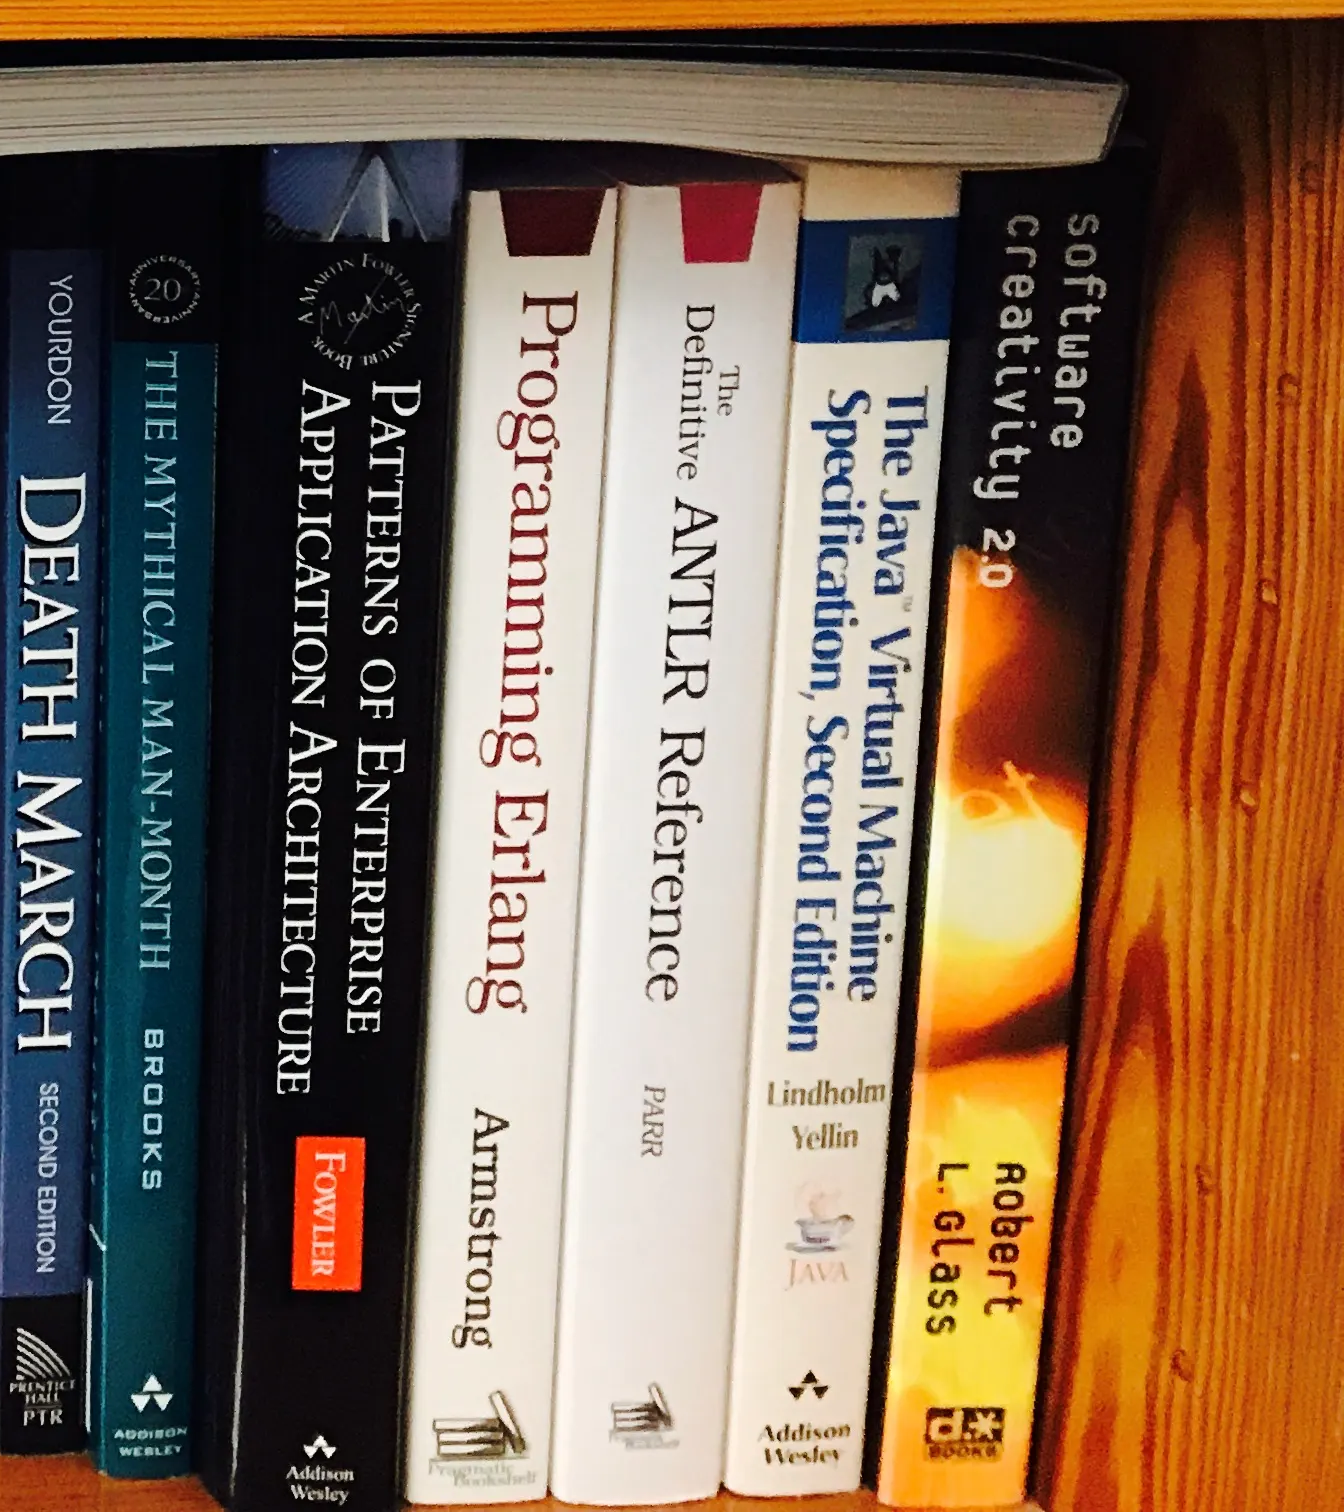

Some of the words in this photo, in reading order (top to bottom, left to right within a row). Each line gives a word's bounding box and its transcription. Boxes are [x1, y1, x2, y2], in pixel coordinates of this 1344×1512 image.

[47, 274, 72, 426] YOURDON
[677, 304, 715, 481] Definitive
[717, 365, 739, 416] The
[971, 214, 1040, 501] creativity
[1049, 211, 1106, 450] software
[144, 350, 178, 441] THE
[141, 452, 177, 684] MYTHICAL
[663, 496, 718, 705] ANTLR
[975, 527, 1016, 589] 2.0
[138, 698, 173, 971] MAN-MONTH
[644, 727, 706, 1002] Reference
[640, 1085, 666, 1158] PARR
[767, 1079, 887, 1107] Lindholm
[792, 1124, 858, 1150] Yellin
[936, 1161, 969, 1194] L.
[984, 1161, 1033, 1315] Robert
[925, 1209, 975, 1336] Glass
[286, 1464, 354, 1482] Addison
[290, 1485, 349, 1505] Wesley
